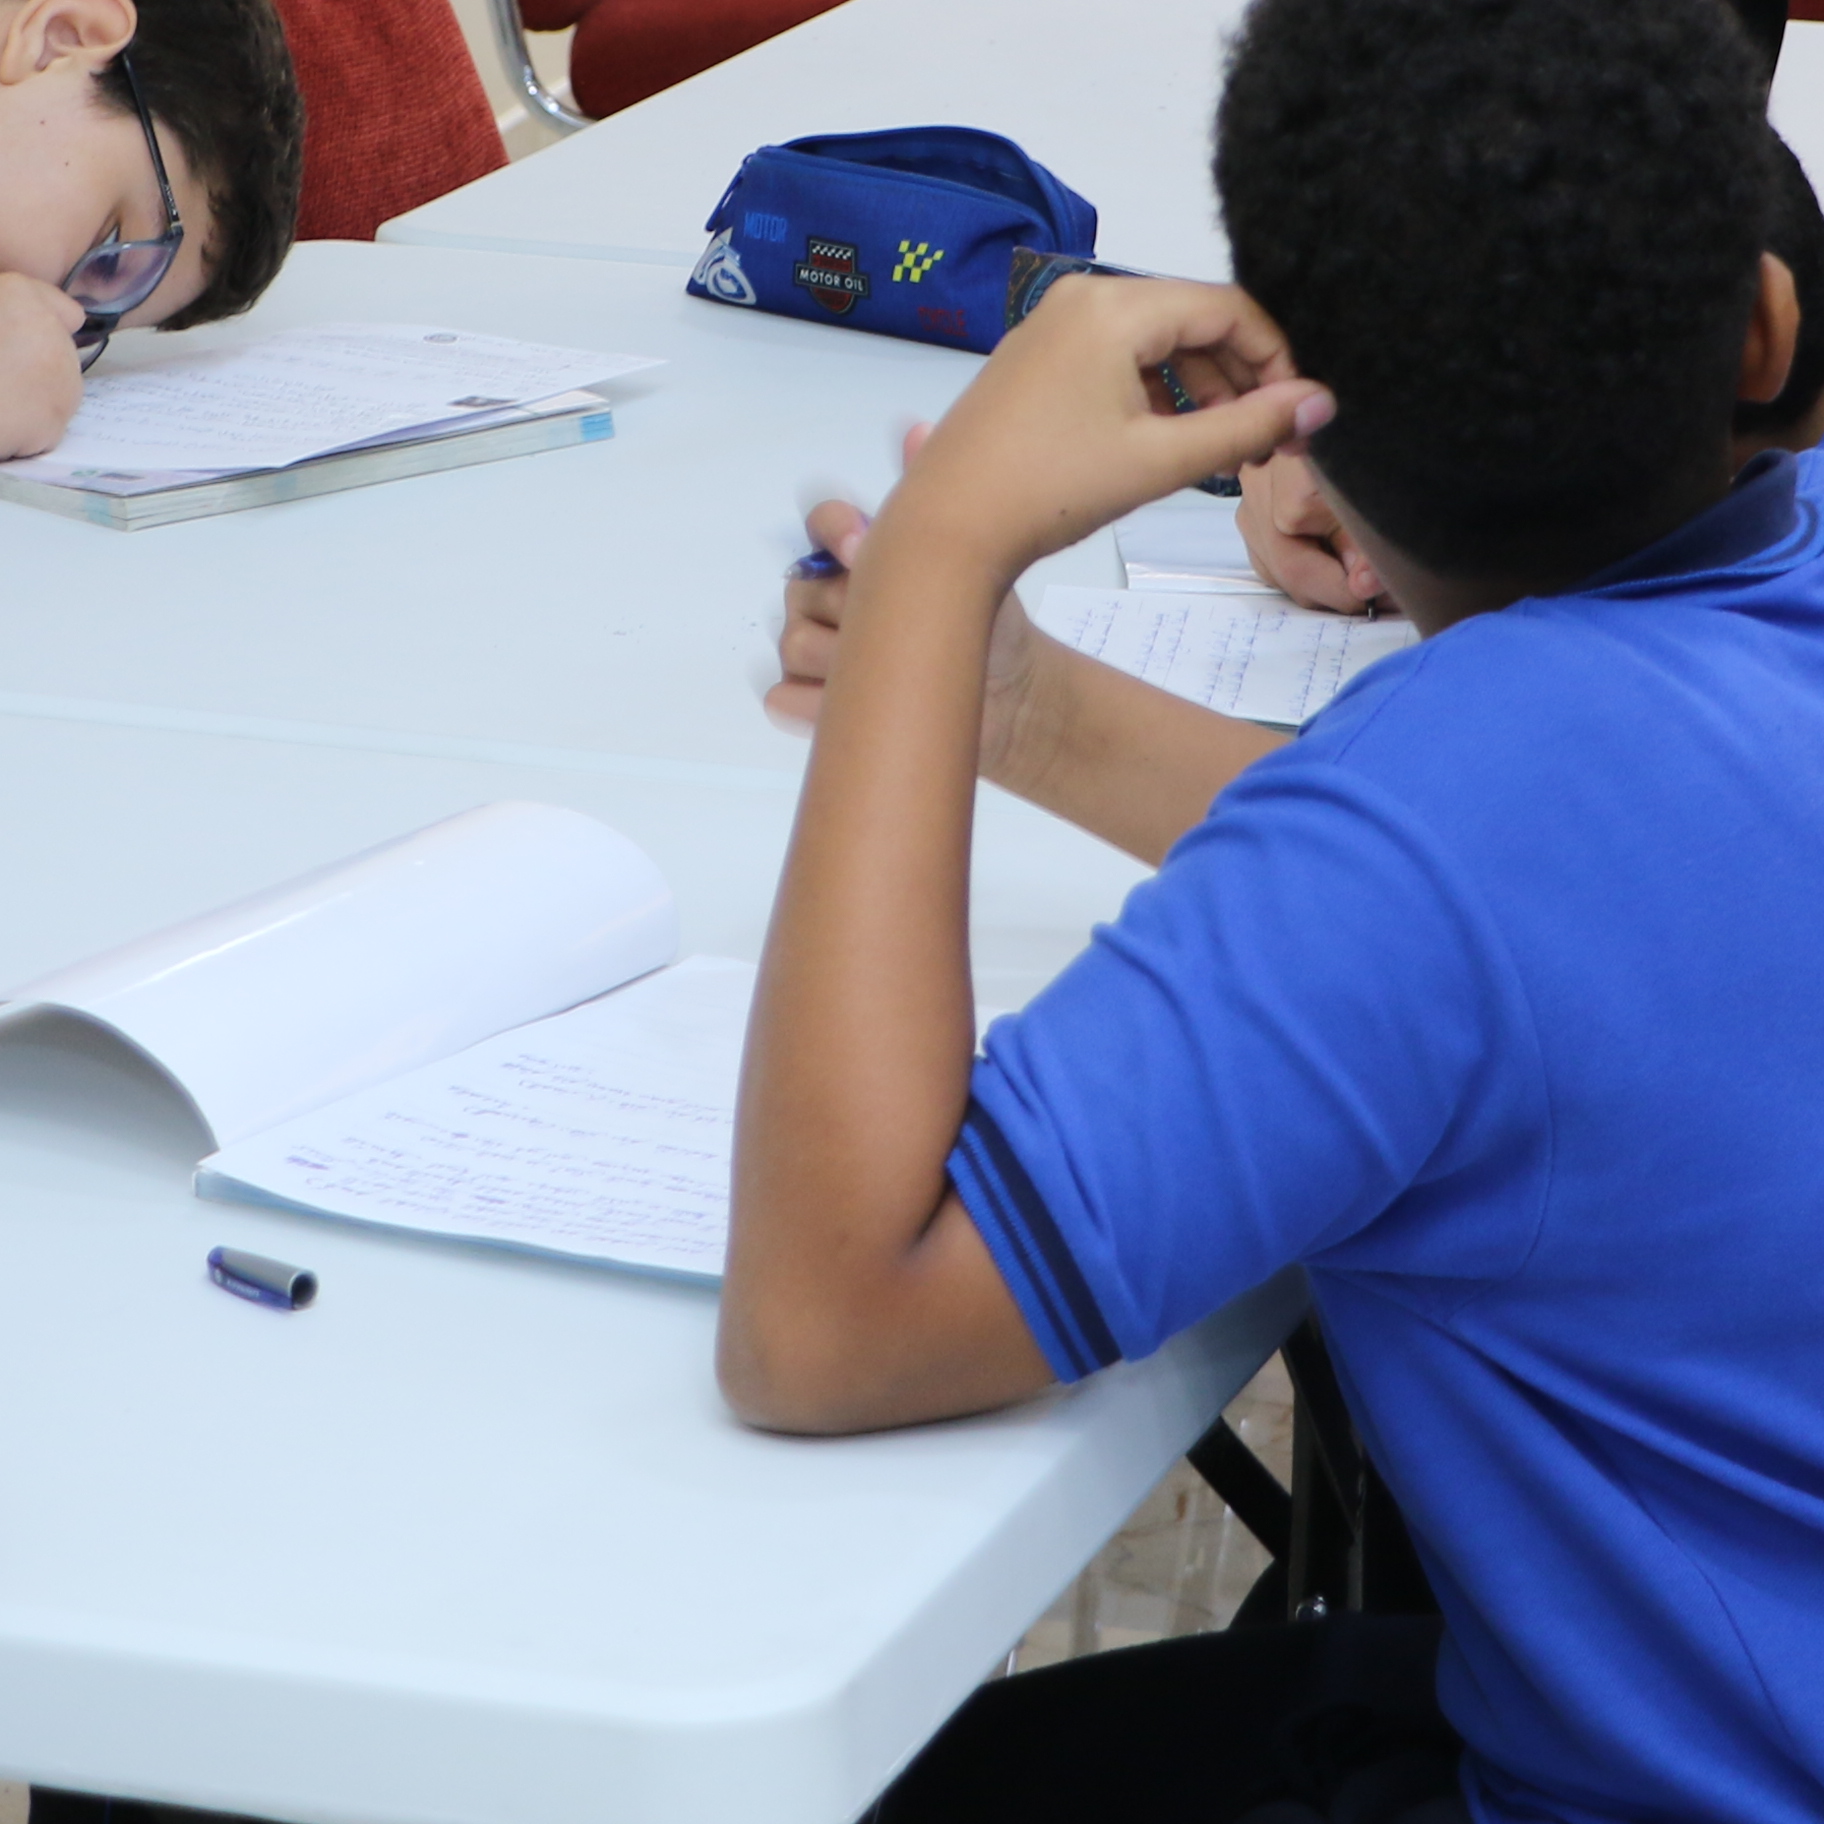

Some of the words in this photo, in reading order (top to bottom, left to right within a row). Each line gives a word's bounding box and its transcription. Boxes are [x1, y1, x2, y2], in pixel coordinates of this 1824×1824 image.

[744, 212, 788, 243] MOTOR
[799, 268, 841, 288] MOTOR
[844, 277, 864, 292] OIL
